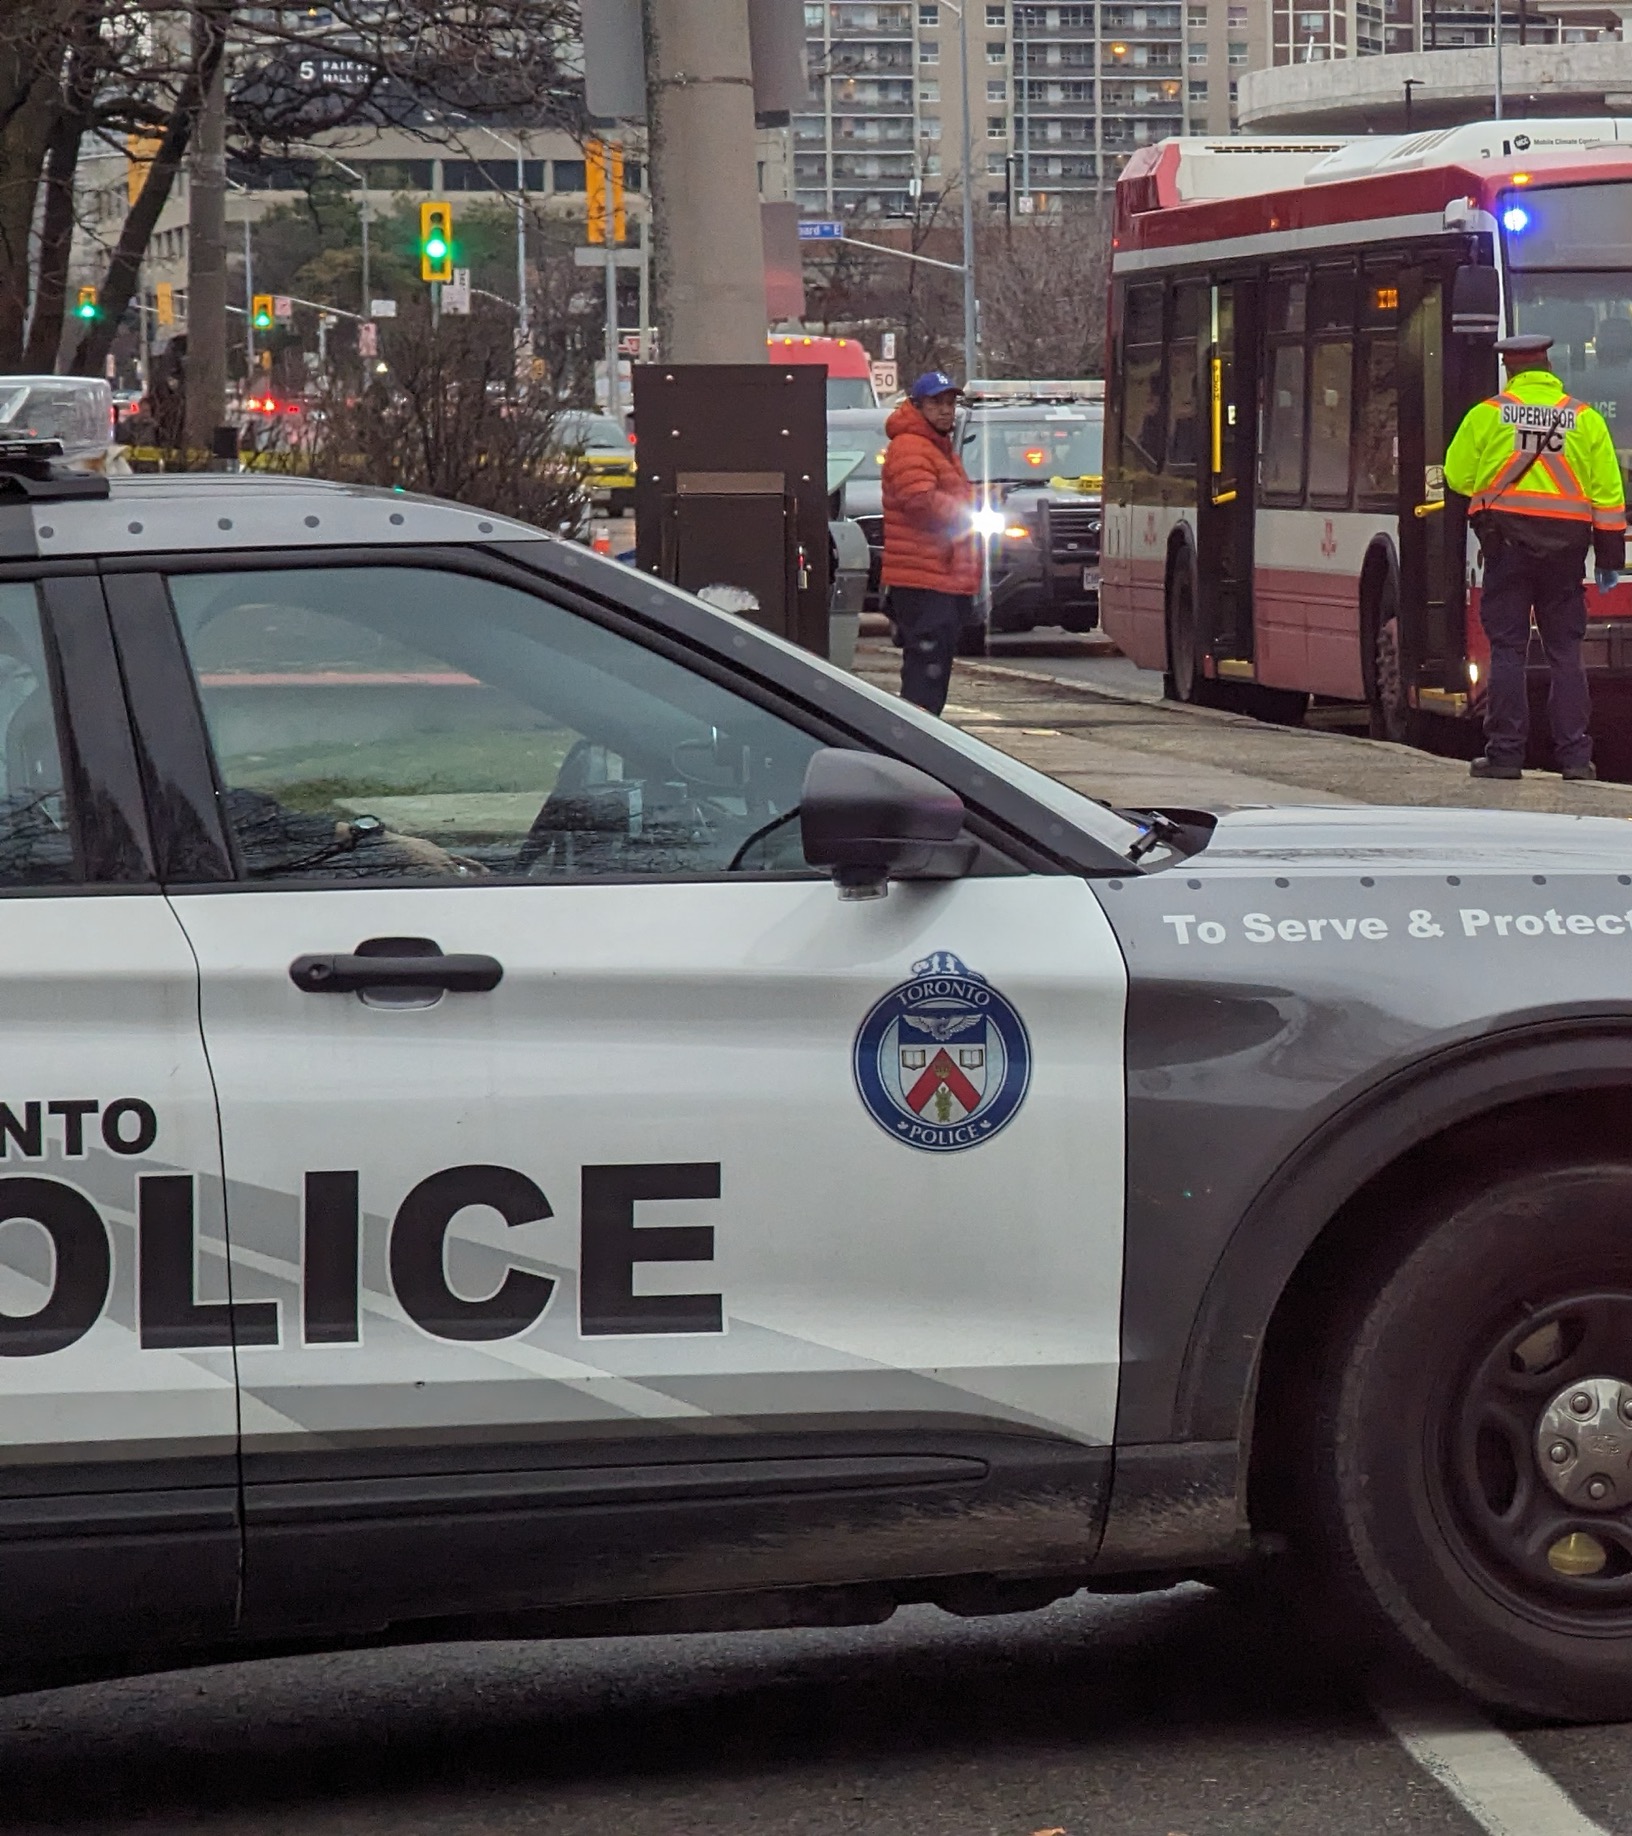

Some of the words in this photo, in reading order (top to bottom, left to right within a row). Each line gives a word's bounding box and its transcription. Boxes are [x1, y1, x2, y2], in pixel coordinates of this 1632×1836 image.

[300, 61, 315, 80] 5
[875, 373, 895, 387] 50
[1502, 404, 1576, 430] SUPERVISOR
[1518, 429, 1563, 453] TTC
[1163, 914, 1227, 945] To
[1242, 912, 1389, 944] Serve
[1407, 909, 1445, 939] &
[896, 980, 990, 1006] TORONTO
[0, 1098, 158, 1156] NTO
[909, 1125, 980, 1145] POLICE
[0, 1161, 724, 1358] OLICE
